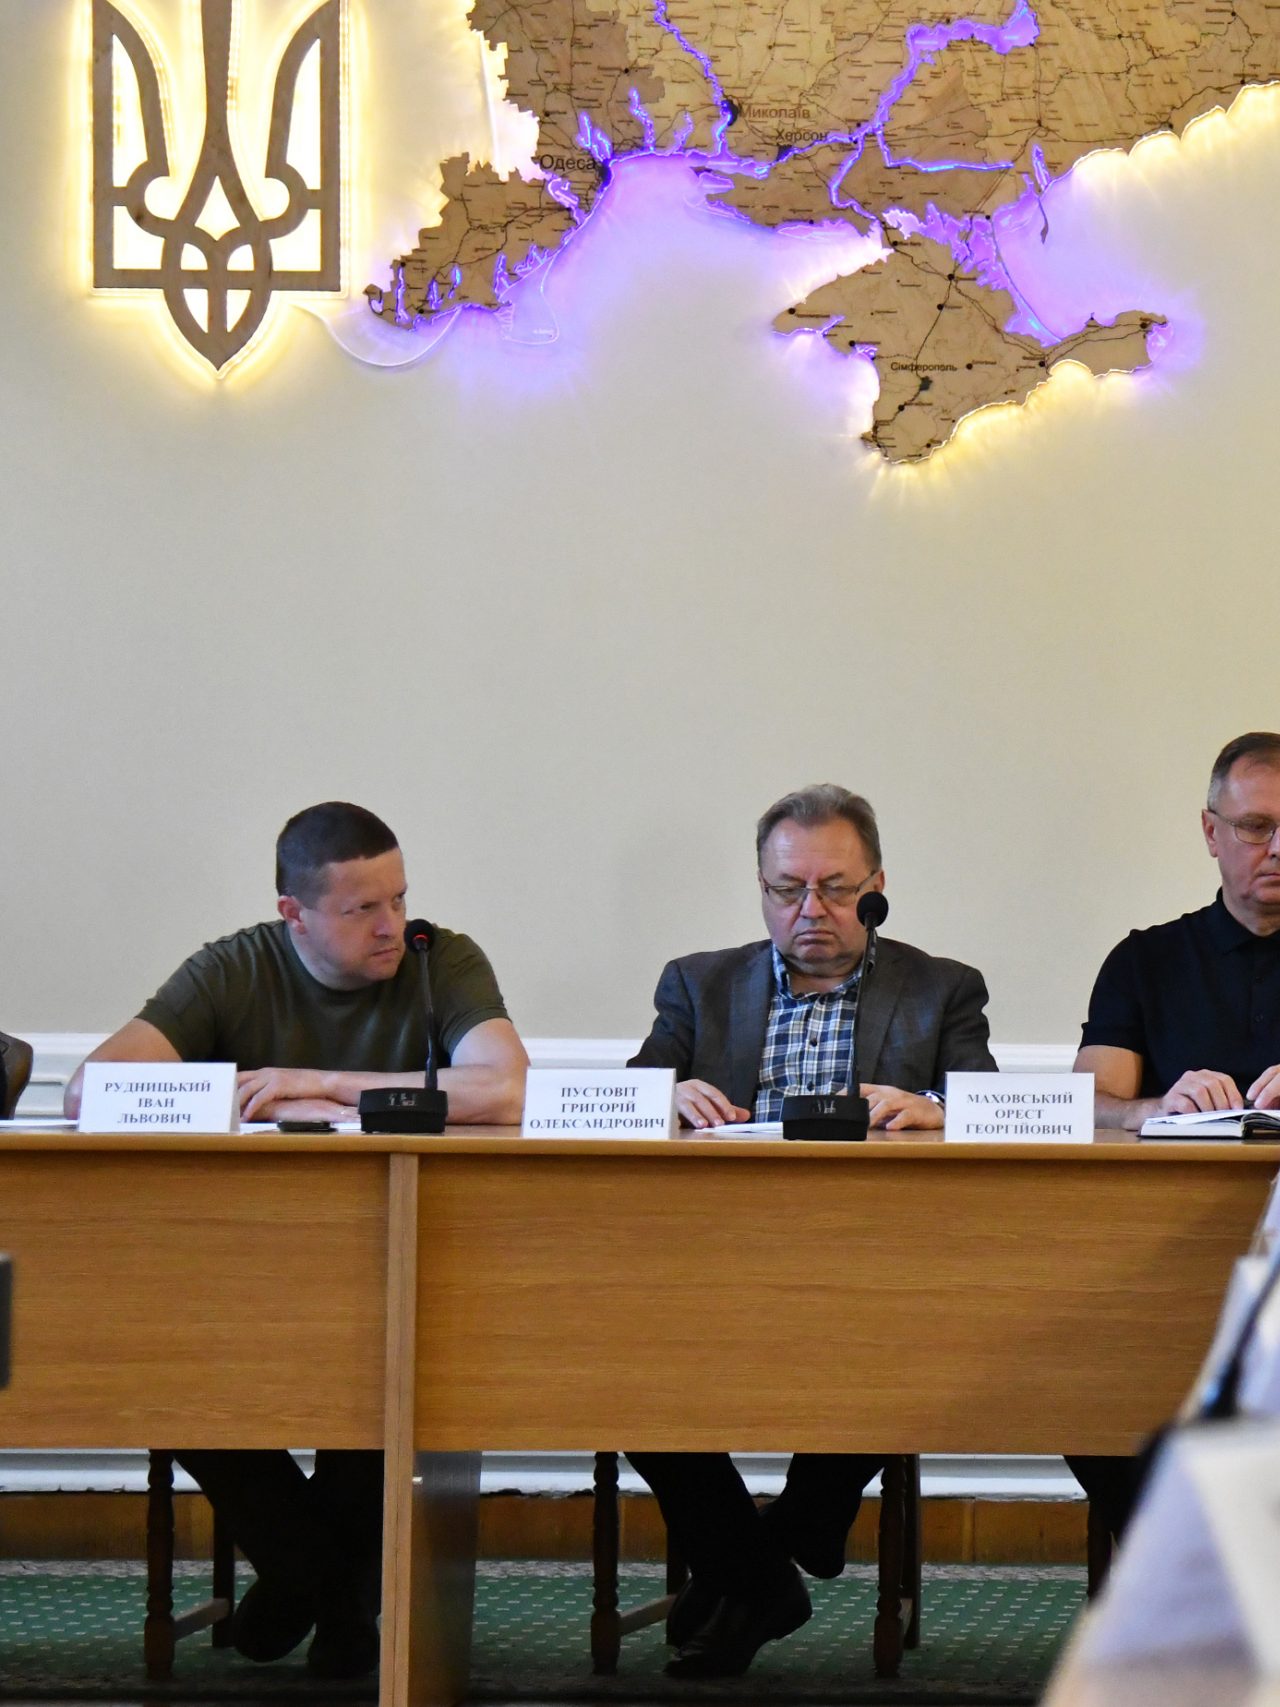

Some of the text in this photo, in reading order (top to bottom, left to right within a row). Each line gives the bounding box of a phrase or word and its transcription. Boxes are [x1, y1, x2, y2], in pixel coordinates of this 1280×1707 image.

[775, 128, 829, 143] Херсон
[539, 153, 596, 172] Одеса
[104, 1079, 211, 1094] РУДНИЦЬКИЙ
[560, 1086, 639, 1098] ПУСТОВІТ
[137, 1097, 175, 1108] ІВАН
[966, 1090, 1074, 1104] МАХОВСЬКИЙ
[561, 1100, 636, 1113] ГРИГОРІЙ
[117, 1113, 192, 1124] ЛЬВОВИЧ
[994, 1108, 1045, 1120] ОРЕСТ
[529, 1118, 665, 1130] ОЛЕКСАНДРОВИЧ
[965, 1122, 1073, 1135] ГЕОРГІЙОВИЧ
